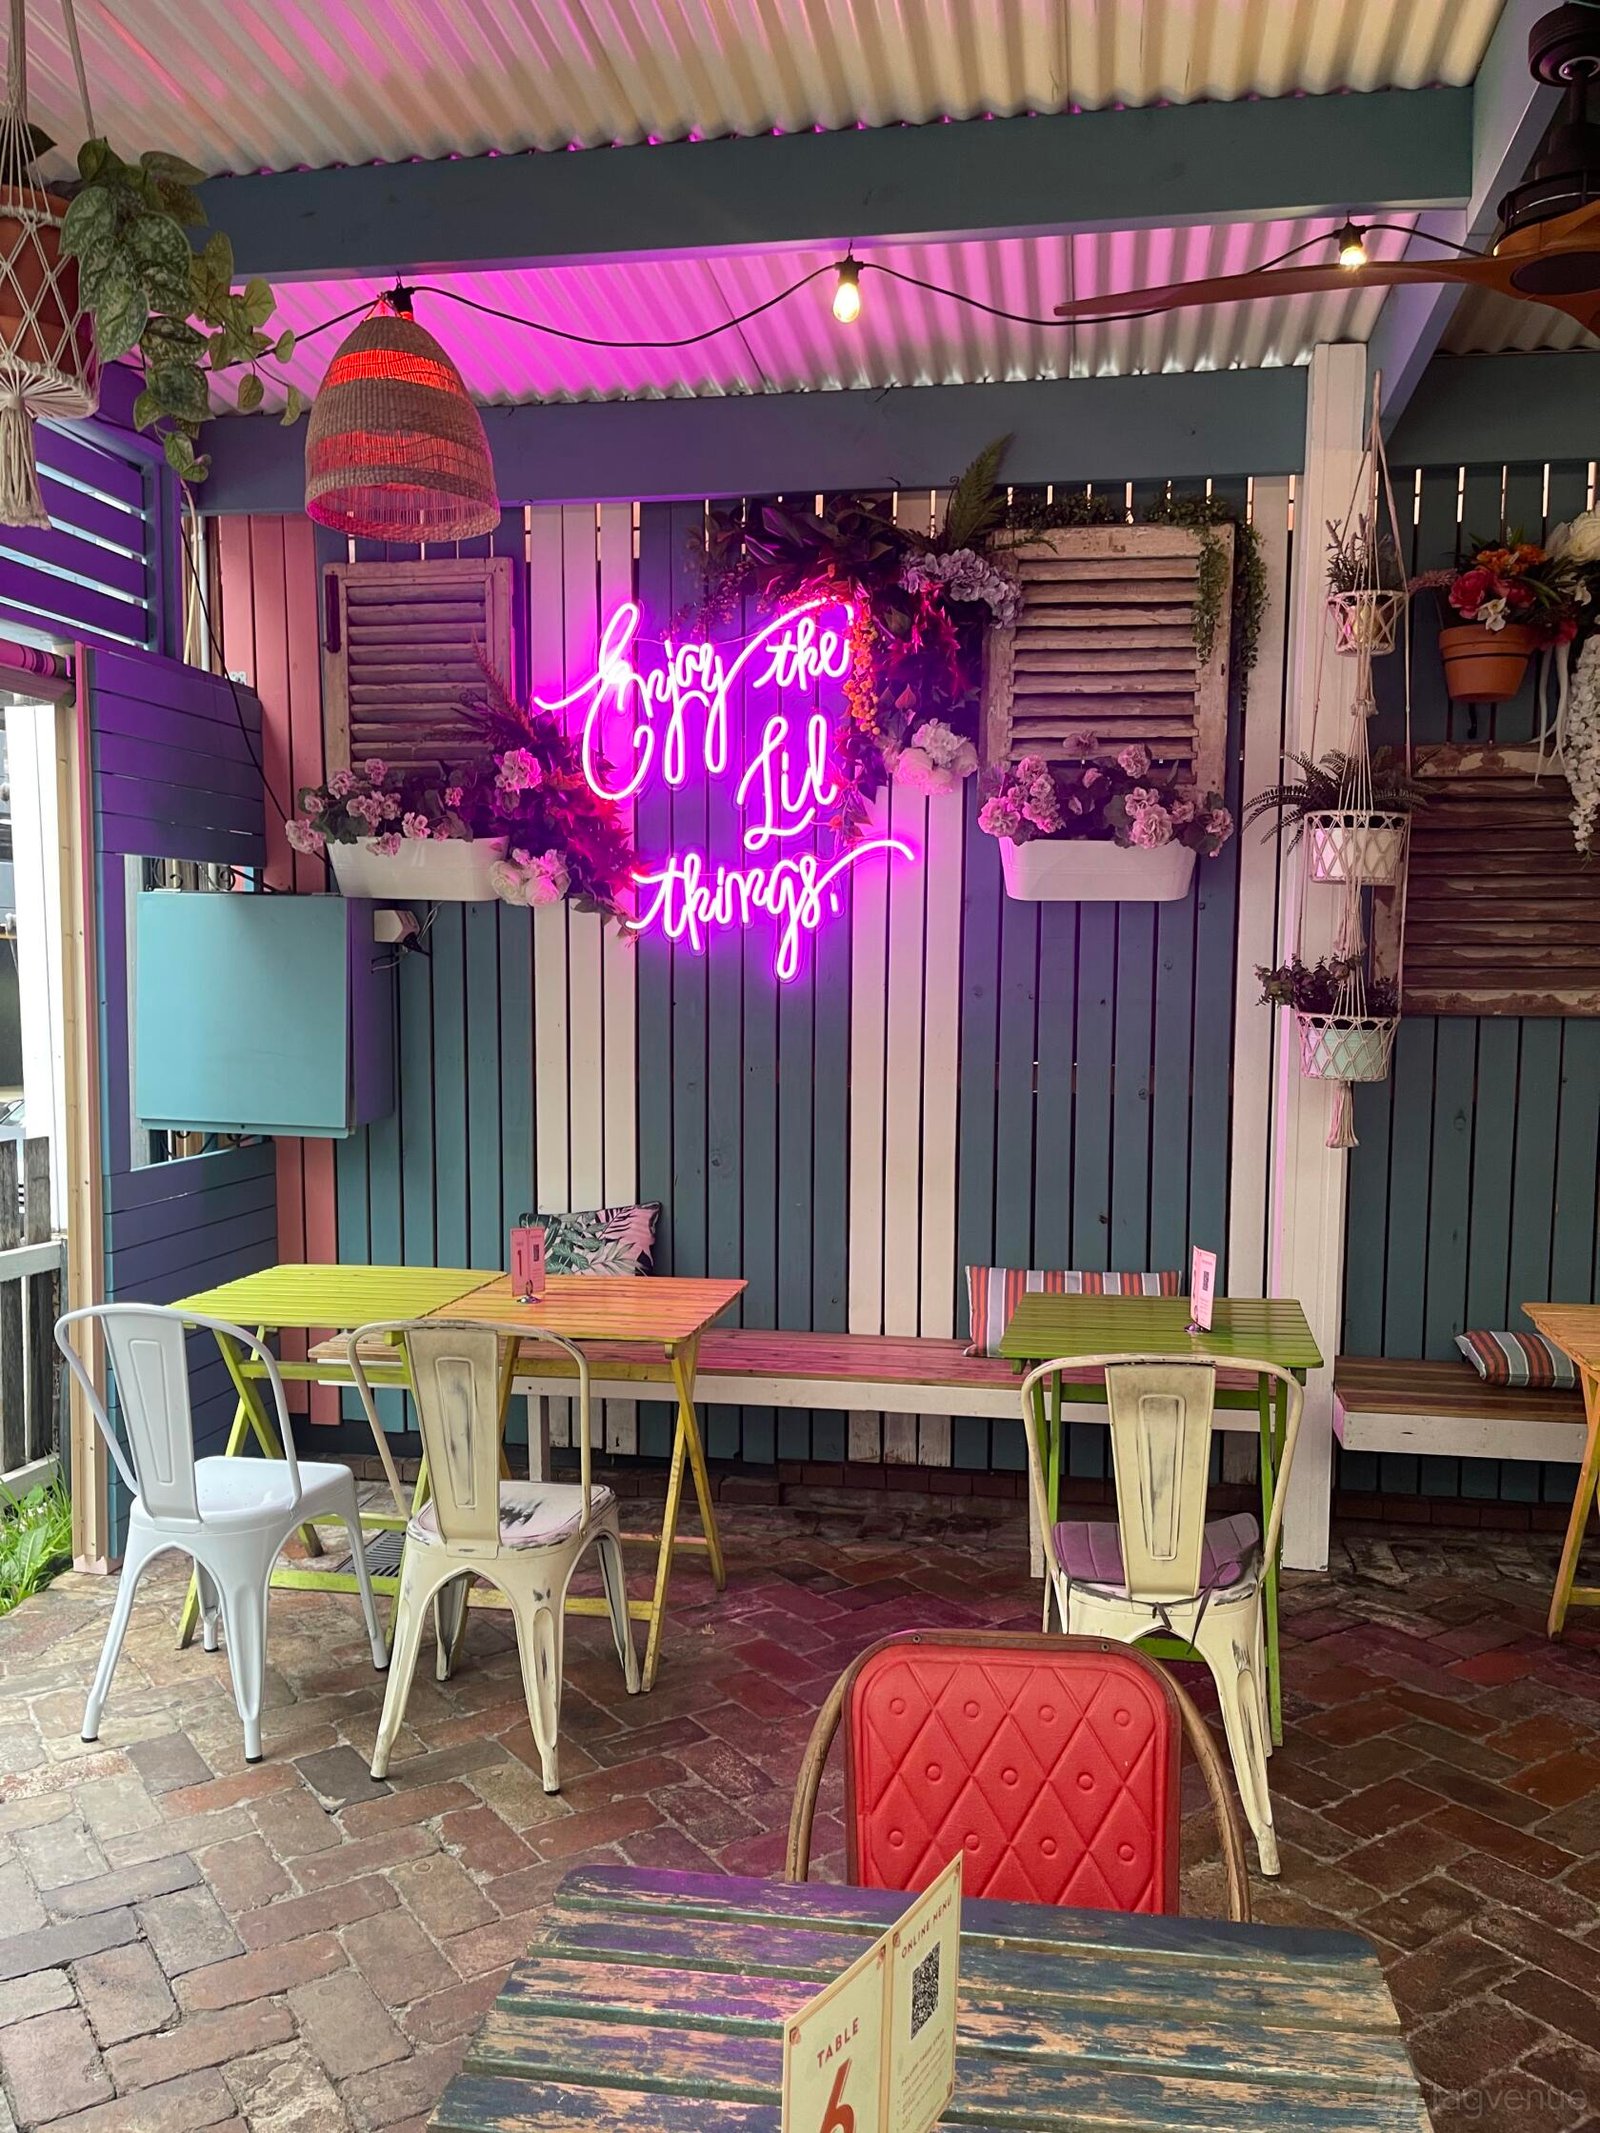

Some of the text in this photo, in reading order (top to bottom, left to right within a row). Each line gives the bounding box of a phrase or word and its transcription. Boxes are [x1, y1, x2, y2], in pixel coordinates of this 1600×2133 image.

[534, 602, 850, 800] Enjoy the
[736, 714, 837, 851] Lil
[901, 1893, 952, 1959] ONLINE MENU
[817, 2017, 859, 2069] TABLE
